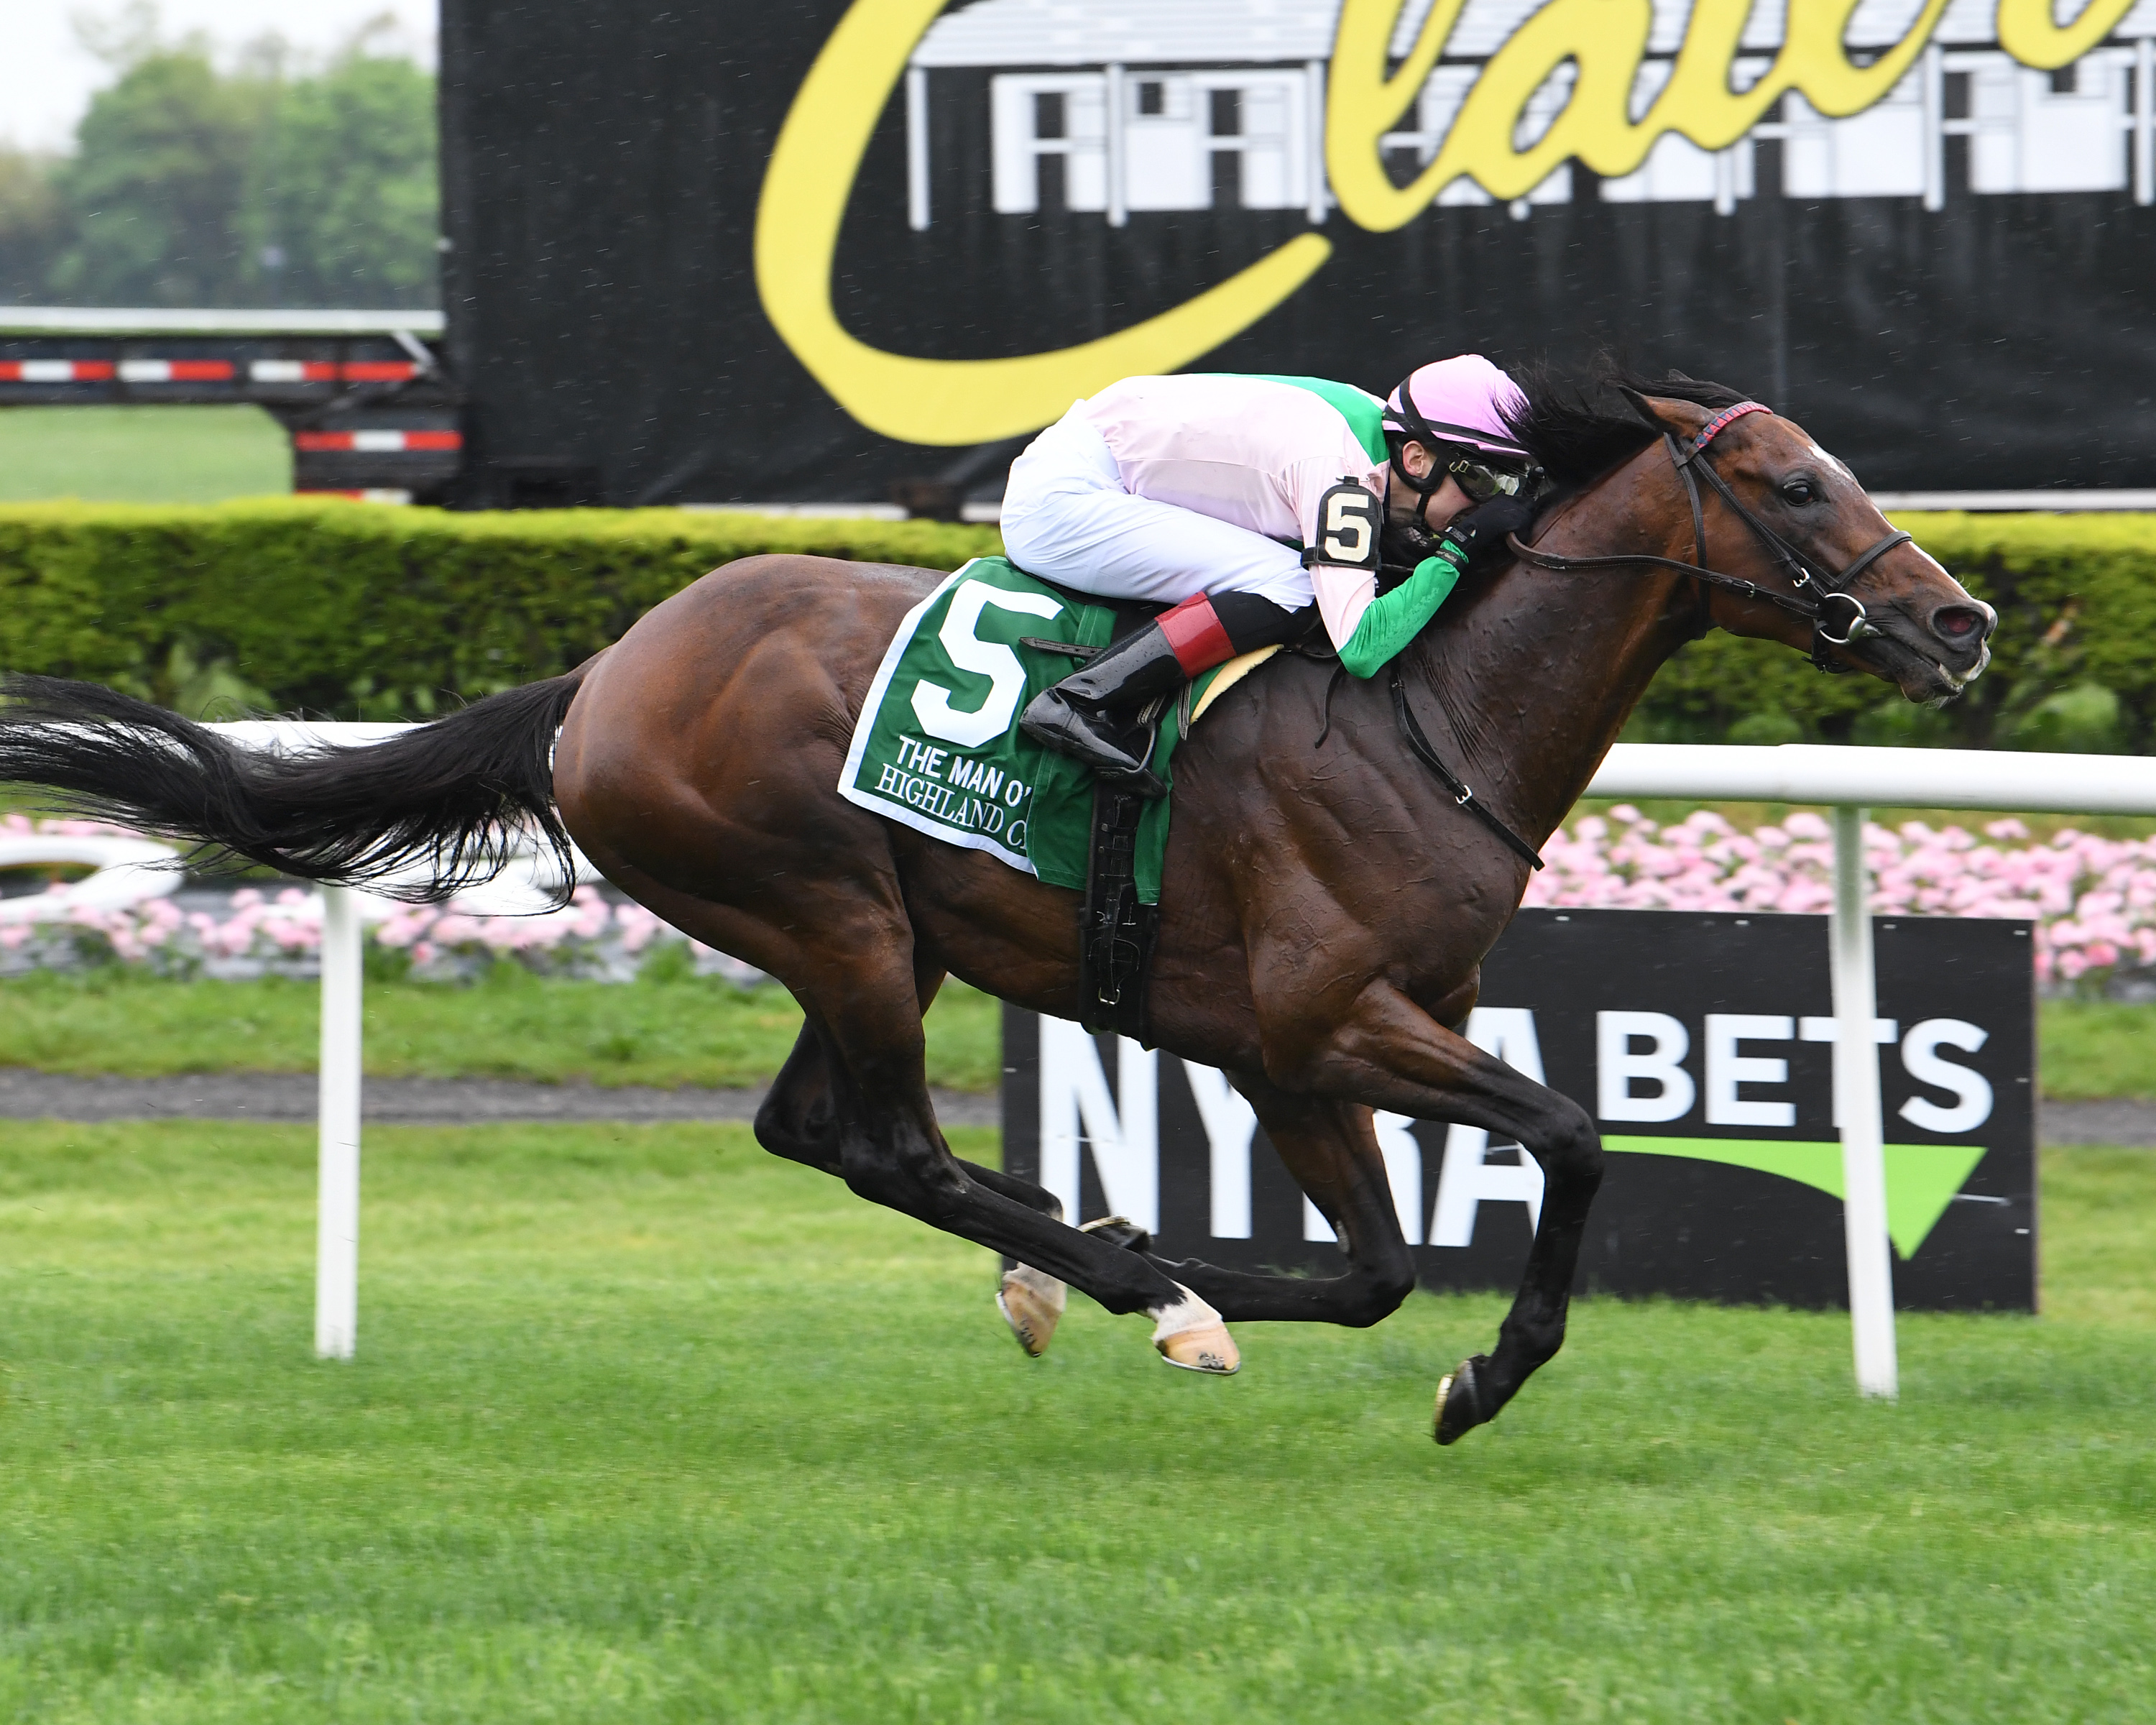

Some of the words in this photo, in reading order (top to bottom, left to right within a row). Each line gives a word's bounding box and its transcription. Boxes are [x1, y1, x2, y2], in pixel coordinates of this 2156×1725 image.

[1324, 492, 1373, 564] 5
[910, 579, 1064, 748] 5
[874, 763, 1005, 834] HIGHLAND
[1006, 819, 1028, 850] C
[898, 735, 949, 779] THE
[947, 755, 1005, 799] MAN
[1005, 779, 1032, 807] O'
